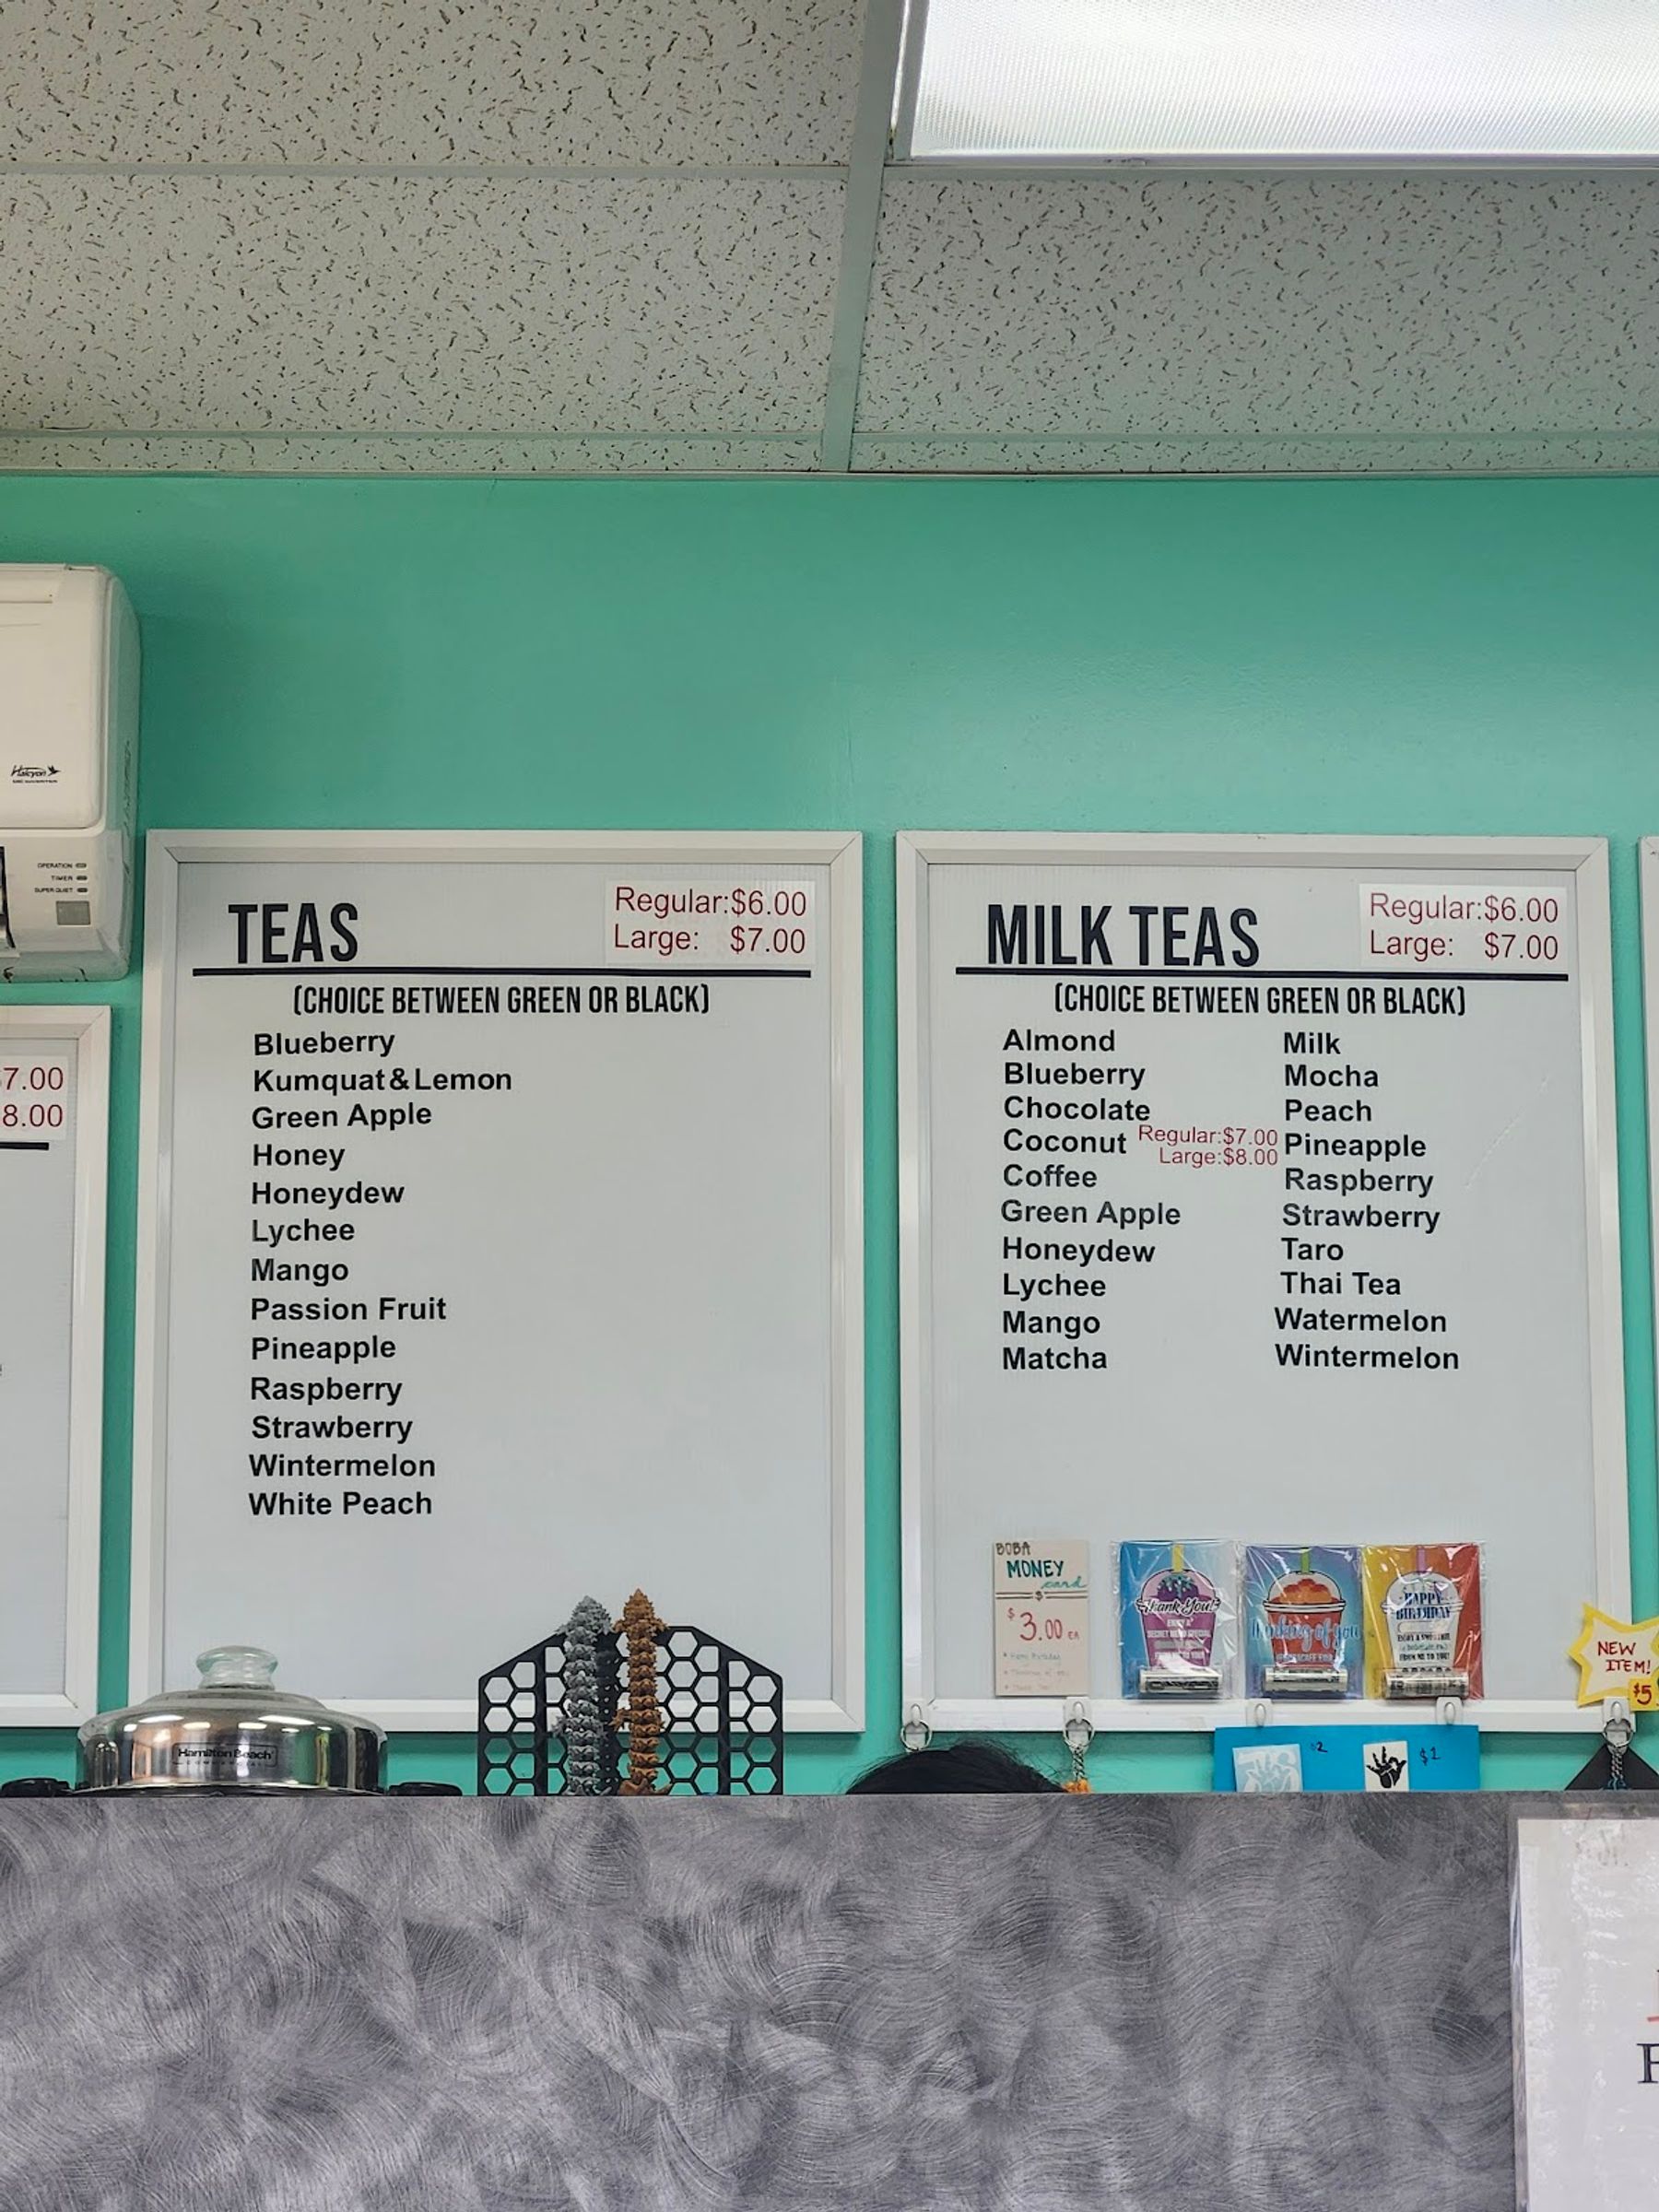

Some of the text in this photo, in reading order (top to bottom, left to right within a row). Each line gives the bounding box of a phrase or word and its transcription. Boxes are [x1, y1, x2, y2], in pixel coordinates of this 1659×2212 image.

[229, 903, 359, 965] TEAS
[615, 923, 806, 957] Large: $7.00
[988, 904, 1260, 967] MILK TEAS
[1371, 928, 1559, 962] Large: $7.00
[393, 986, 500, 1014] BETWEEN
[508, 986, 580, 1013] GREEN
[589, 986, 618, 1013] OR
[1153, 986, 1259, 1014] BETWEEN
[1267, 987, 1339, 1014] GREEN
[1347, 987, 1375, 1014] OR
[254, 1031, 394, 1057] Blueberry
[1003, 1029, 1114, 1052] Almond
[1284, 1031, 1342, 1054] Milk
[0, 1066, 64, 1091] 7.00
[1005, 1062, 1146, 1091] Blueberry
[1284, 1065, 1378, 1088] Mocha
[252, 1102, 431, 1132] Green Apple
[1005, 1096, 1151, 1122] Chocolate
[1285, 1099, 1372, 1122] Peach
[1004, 1128, 1126, 1154] Coconut
[1285, 1133, 1427, 1165] Pineapple
[253, 1144, 345, 1171] Honey
[1004, 1163, 1098, 1188] Coffee
[1285, 1168, 1434, 1198] Raspberry
[252, 1181, 406, 1210] Honeydew
[1001, 1200, 1182, 1230] Green Apple
[1283, 1203, 1441, 1234] Strawberry
[253, 1218, 355, 1248] Lychee
[1004, 1236, 1157, 1267] Honeydew
[1281, 1237, 1345, 1261] Taro
[252, 1258, 348, 1287] Mango
[1280, 1271, 1402, 1295] Thai Tea
[1003, 1273, 1107, 1301] Lychee
[252, 1296, 446, 1320] Passion Fruit
[1274, 1307, 1447, 1332] Watermelon
[1003, 1311, 1100, 1339] Mango
[252, 1335, 395, 1364] Pineapple
[1003, 1347, 1107, 1370] Matcha
[1275, 1344, 1459, 1370] Wintermelon
[252, 1377, 403, 1406] Raspberry
[252, 1416, 413, 1444] Strawberry
[249, 1453, 435, 1477] Wintermelon
[248, 1491, 431, 1515] White Peach
[996, 1542, 1031, 1556] BOBA
[1006, 1559, 1065, 1579] MONEY
[1041, 1576, 1088, 1590] card
[1404, 1592, 1442, 1605] HAPPY
[1597, 1641, 1636, 1656] NEW
[1606, 1659, 1651, 1675] ITEM!
[178, 1747, 271, 1760] Hamilton Beach
